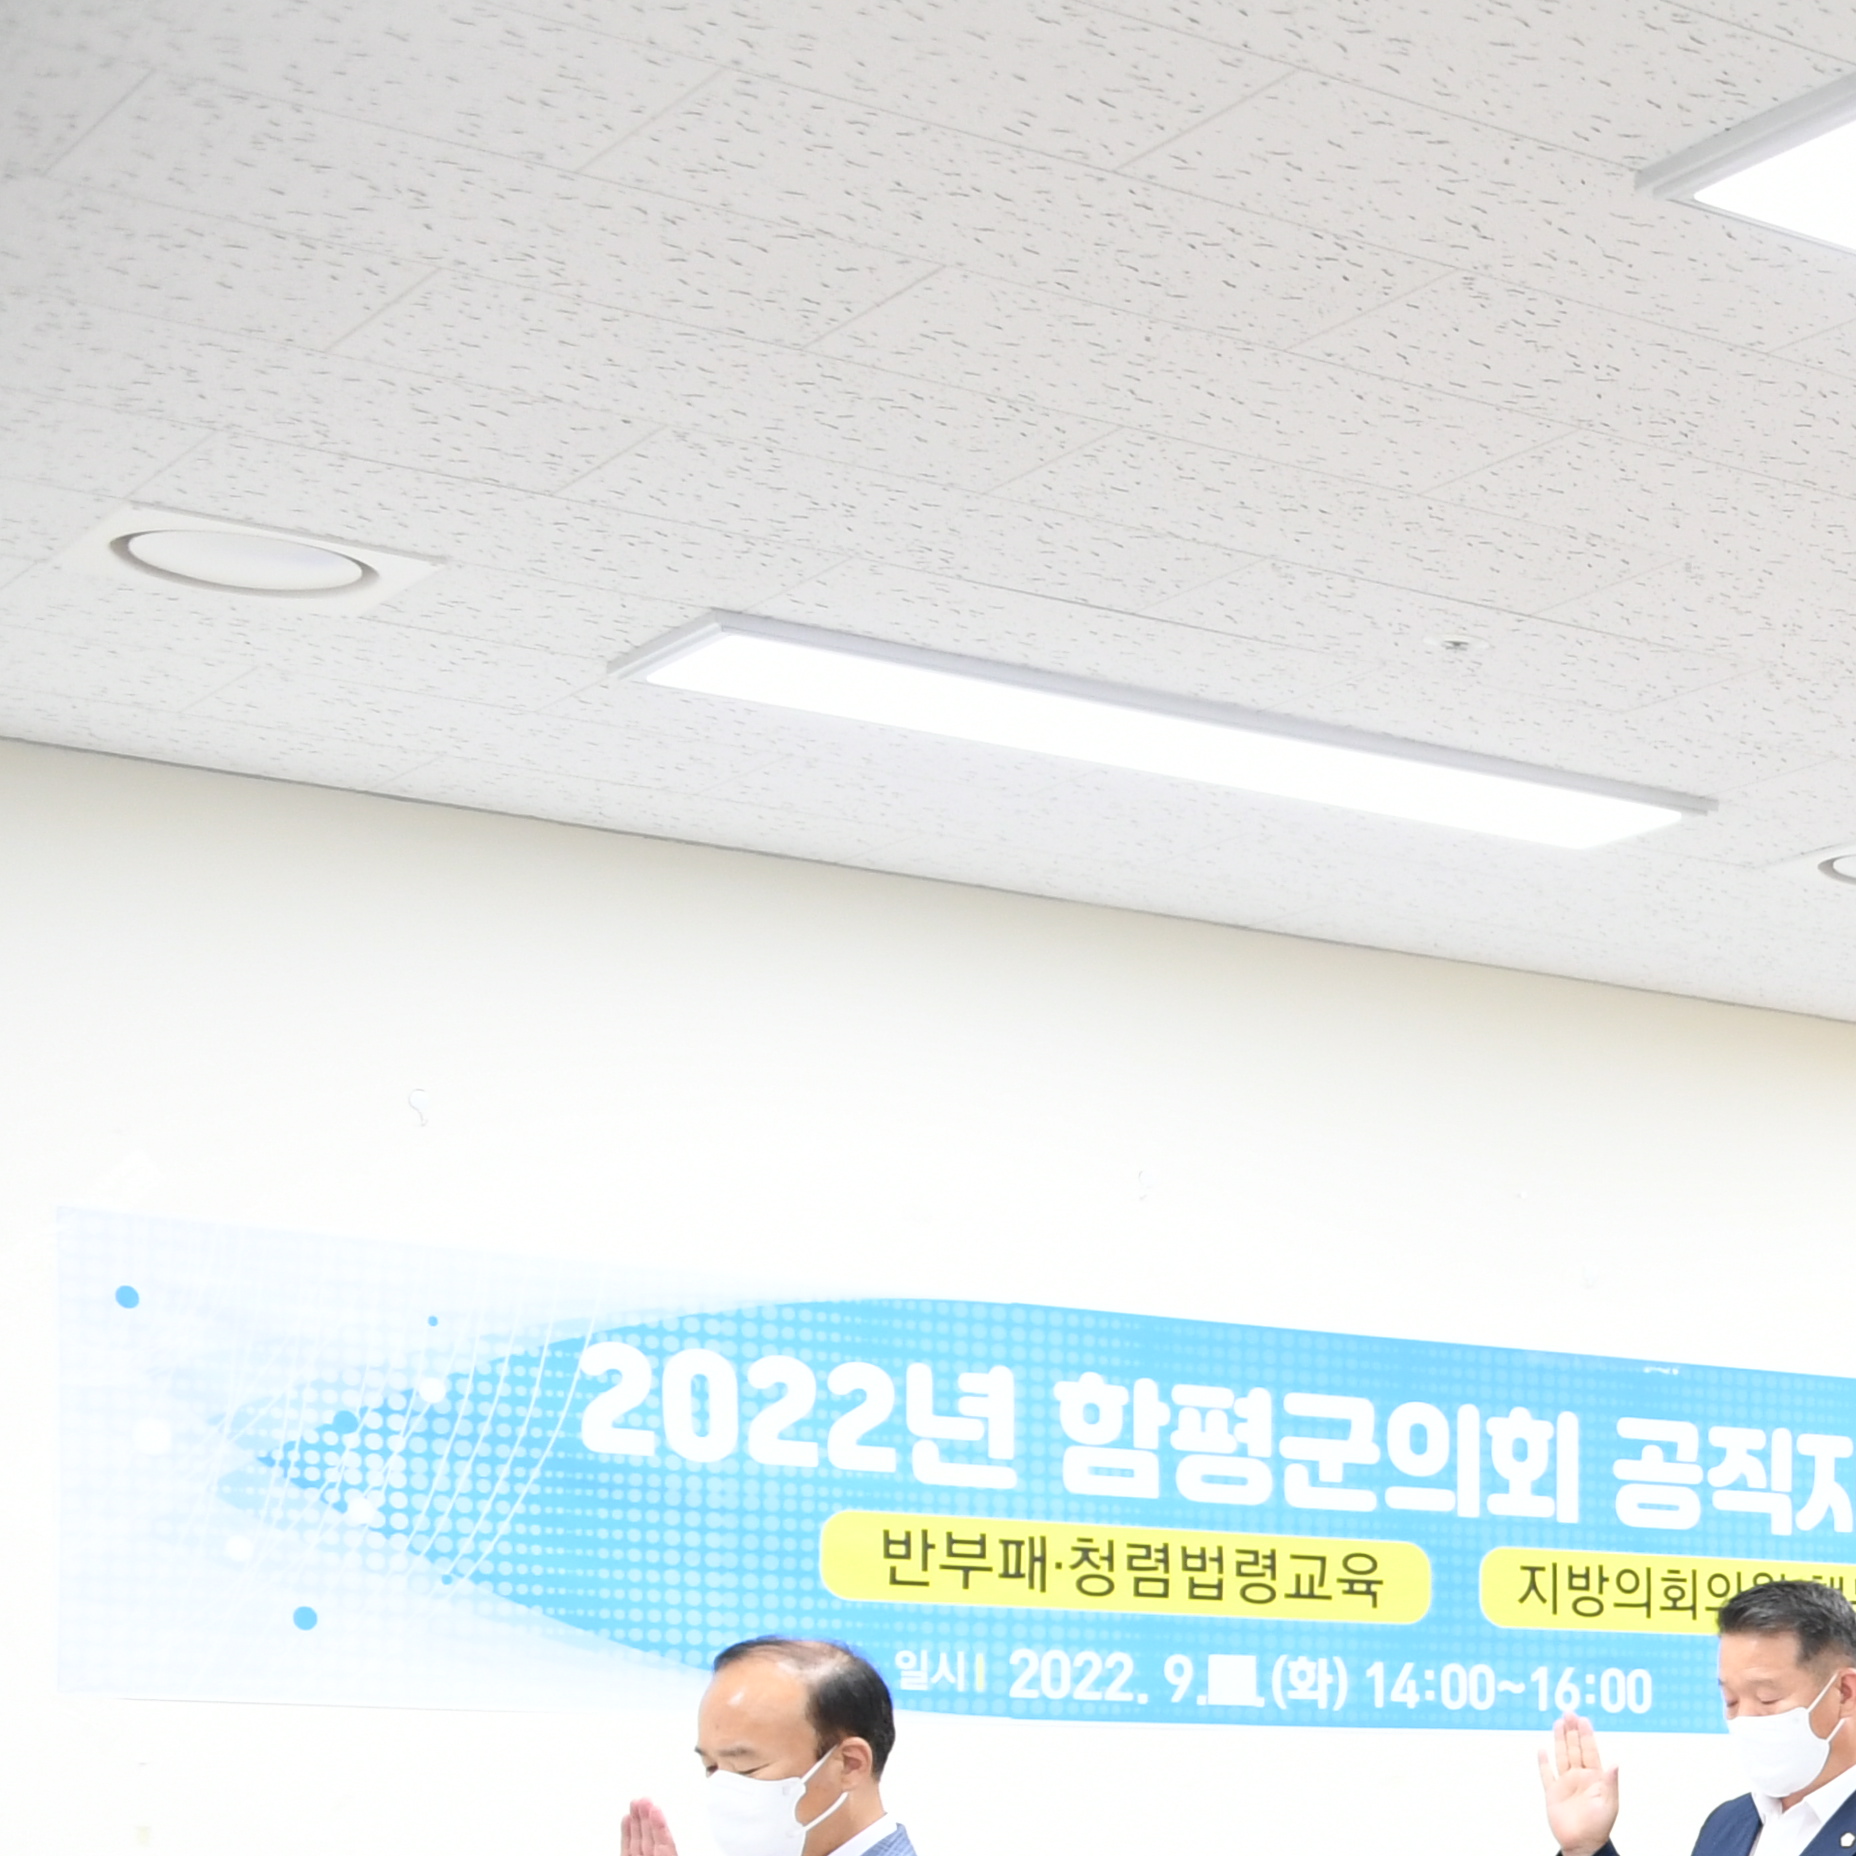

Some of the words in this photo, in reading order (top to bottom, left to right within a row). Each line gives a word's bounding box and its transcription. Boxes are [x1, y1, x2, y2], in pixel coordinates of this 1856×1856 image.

[579, 1341, 1018, 1491] 2022년
[1052, 1371, 1580, 1525] 함평군의회
[881, 1527, 1385, 1609] 반부패·청렴법령교육
[1518, 1561, 1785, 1621] 지방의회의
[895, 1649, 966, 1693] 일시
[1009, 1648, 1148, 1705] 2022.
[1365, 1660, 1653, 1714] 14:00~16:00
